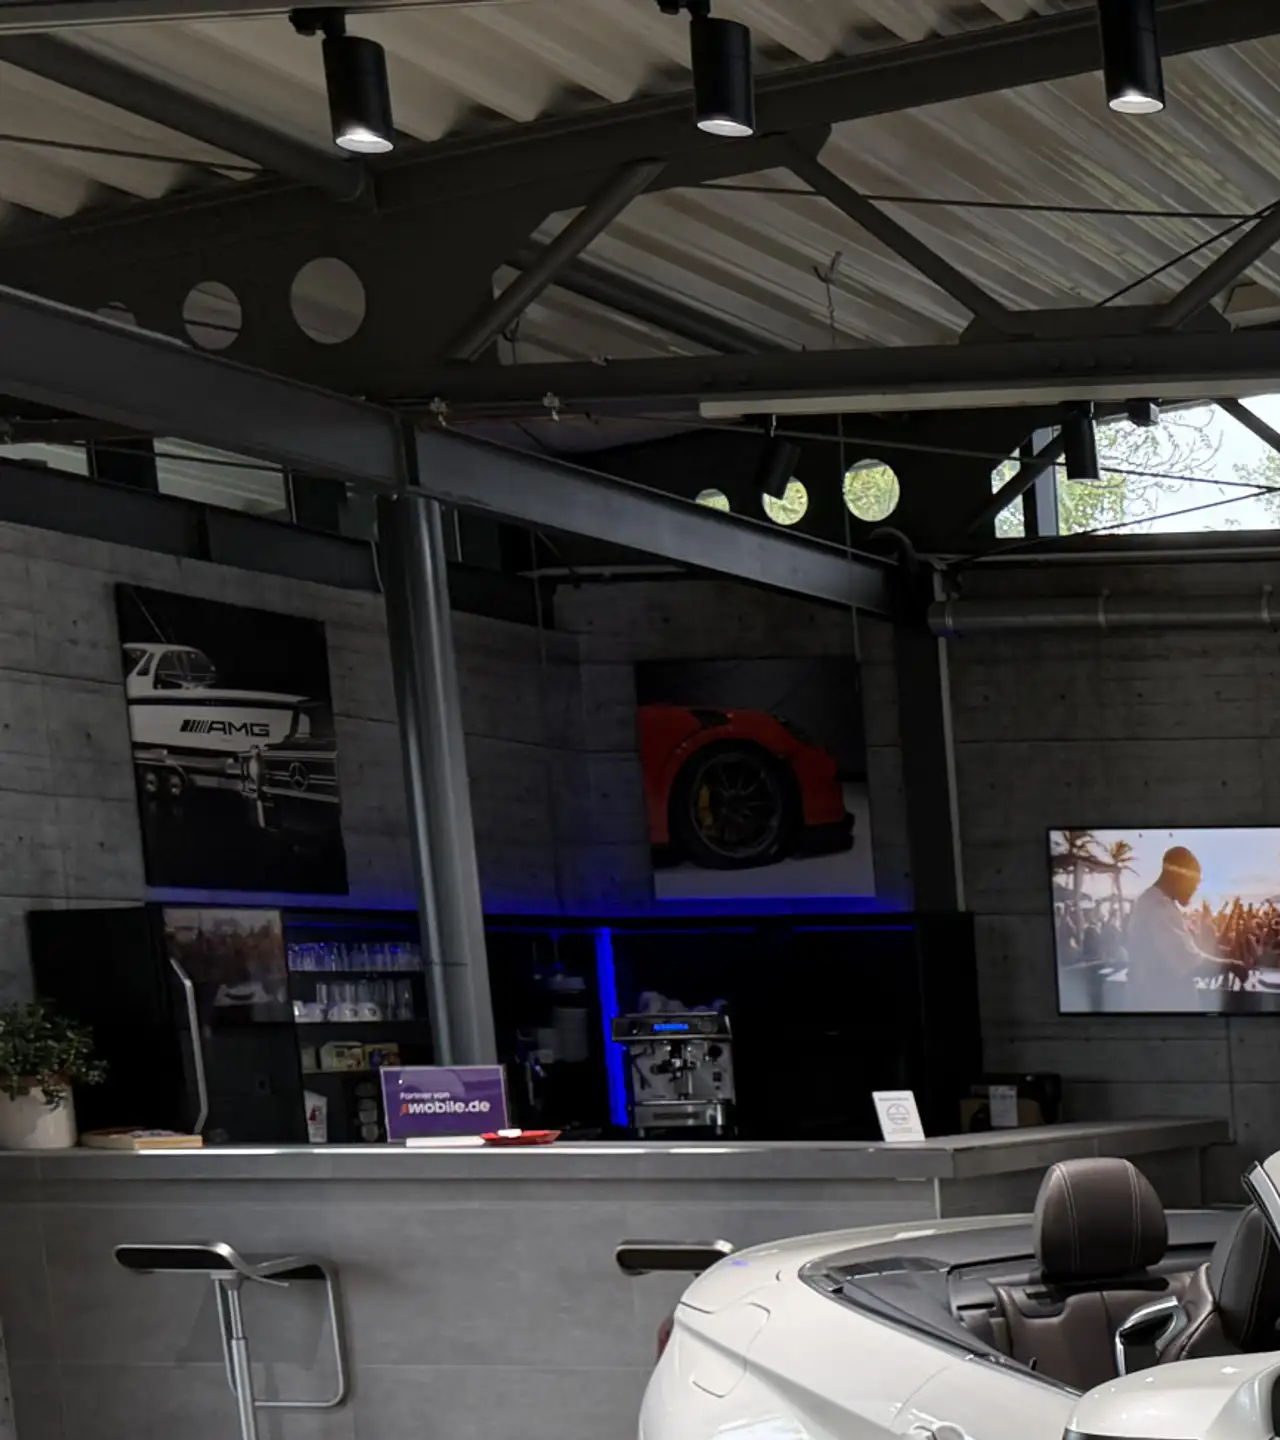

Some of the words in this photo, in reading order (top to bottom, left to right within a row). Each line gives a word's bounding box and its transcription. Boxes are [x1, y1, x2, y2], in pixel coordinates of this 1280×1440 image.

[207, 720, 270, 737] AMG
[399, 1092, 432, 1100] Partner
[433, 1091, 450, 1099] von
[407, 1100, 491, 1114] mobile.de
